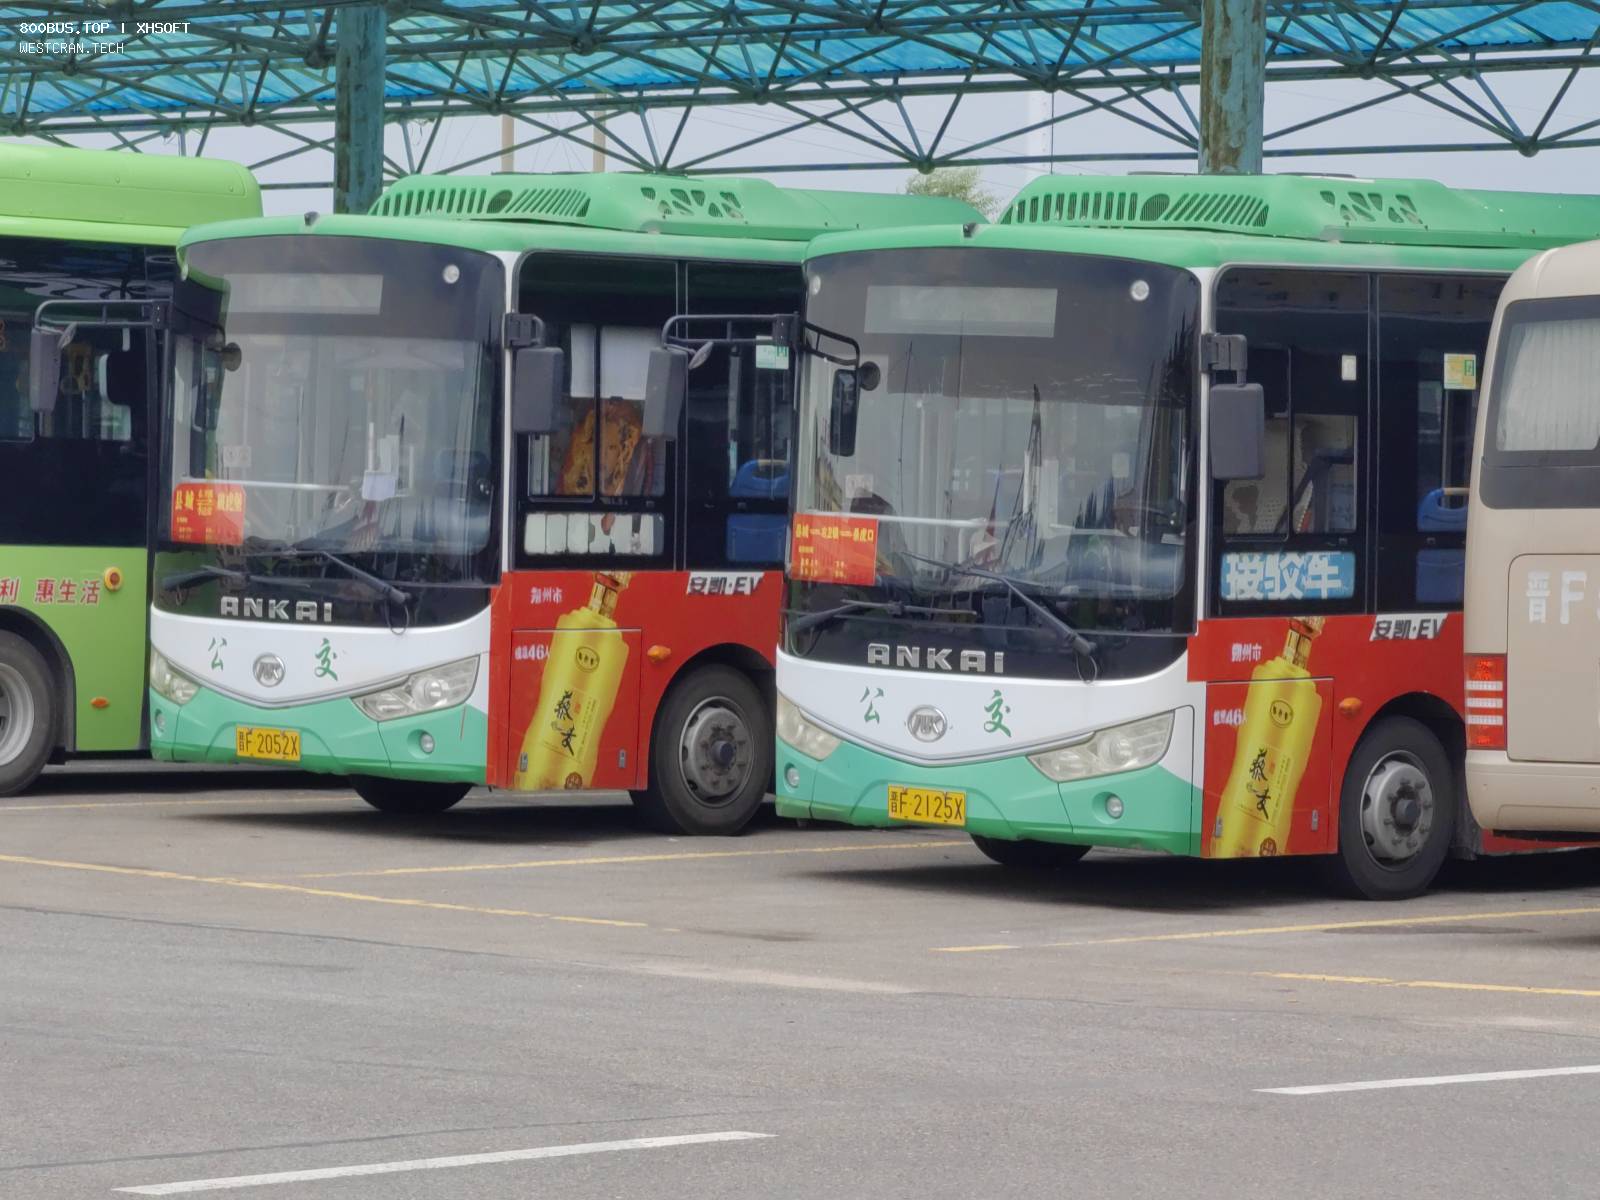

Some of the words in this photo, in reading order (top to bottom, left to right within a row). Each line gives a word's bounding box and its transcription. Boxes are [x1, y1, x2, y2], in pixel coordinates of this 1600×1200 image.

[0, 577, 19, 603] 利
[35, 578, 100, 604] 惠生活
[1224, 552, 1342, 600] 接驳车
[220, 595, 333, 622] ANKAI
[1526, 571, 1600, 625] 晋F
[867, 643, 1004, 673] ANKAI
